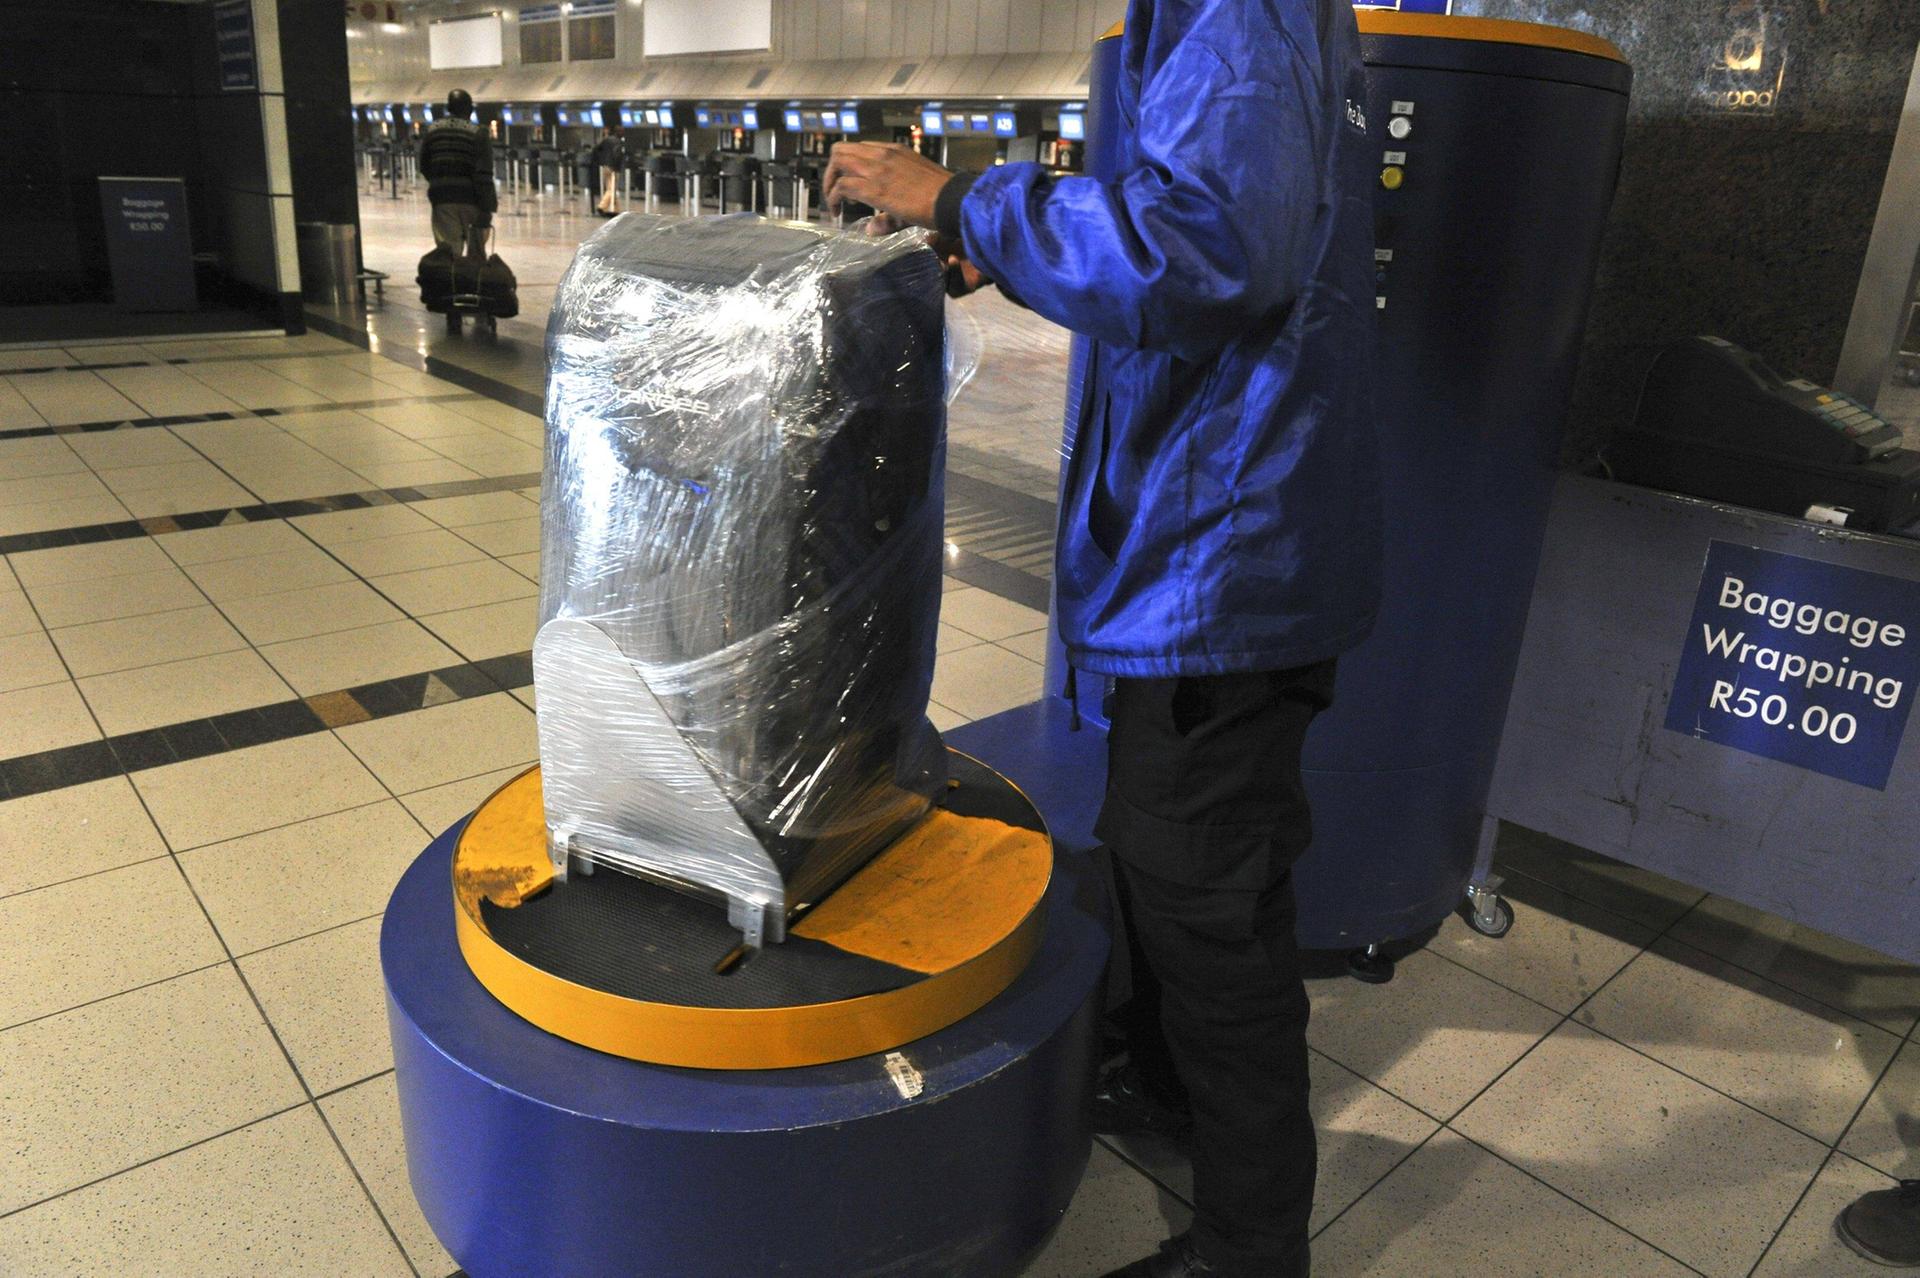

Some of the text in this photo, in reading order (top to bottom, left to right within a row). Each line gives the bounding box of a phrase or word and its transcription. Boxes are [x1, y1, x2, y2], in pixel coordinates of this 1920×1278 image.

[1719, 577, 1906, 648] Baggage
[1703, 623, 1903, 709] Wrapping
[1709, 680, 1857, 744] R50.00
